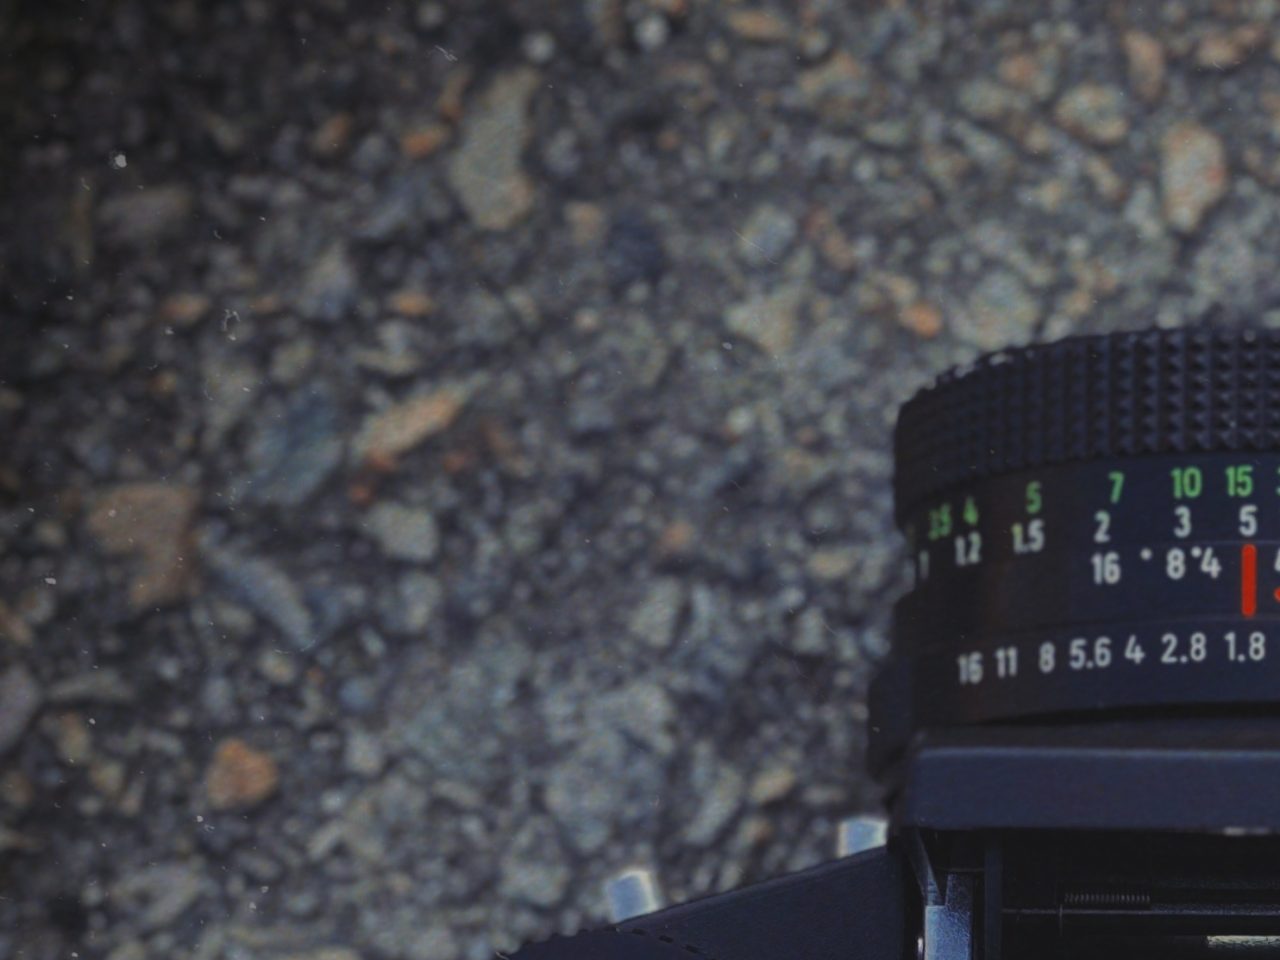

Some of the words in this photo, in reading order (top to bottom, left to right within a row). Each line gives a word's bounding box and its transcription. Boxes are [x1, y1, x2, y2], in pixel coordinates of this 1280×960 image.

[1025, 481, 1042, 514] 5
[1108, 471, 1124, 504] 7
[1171, 467, 1202, 499] 10
[1225, 466, 1254, 497] 15
[1011, 518, 1045, 553] 1.5
[1094, 510, 1110, 543] 2
[1174, 506, 1192, 538] 3
[1239, 504, 1258, 537] 5
[1090, 551, 1121, 585] 16
[1166, 548, 1185, 580] 8
[1200, 547, 1222, 579] 4
[958, 652, 984, 685] 16
[995, 647, 1018, 678] 11
[1038, 642, 1056, 673] 8
[1069, 637, 1112, 669] 5.6
[1123, 635, 1145, 664] 4
[1160, 632, 1207, 663] 2.8
[1223, 632, 1266, 662] 1.8
